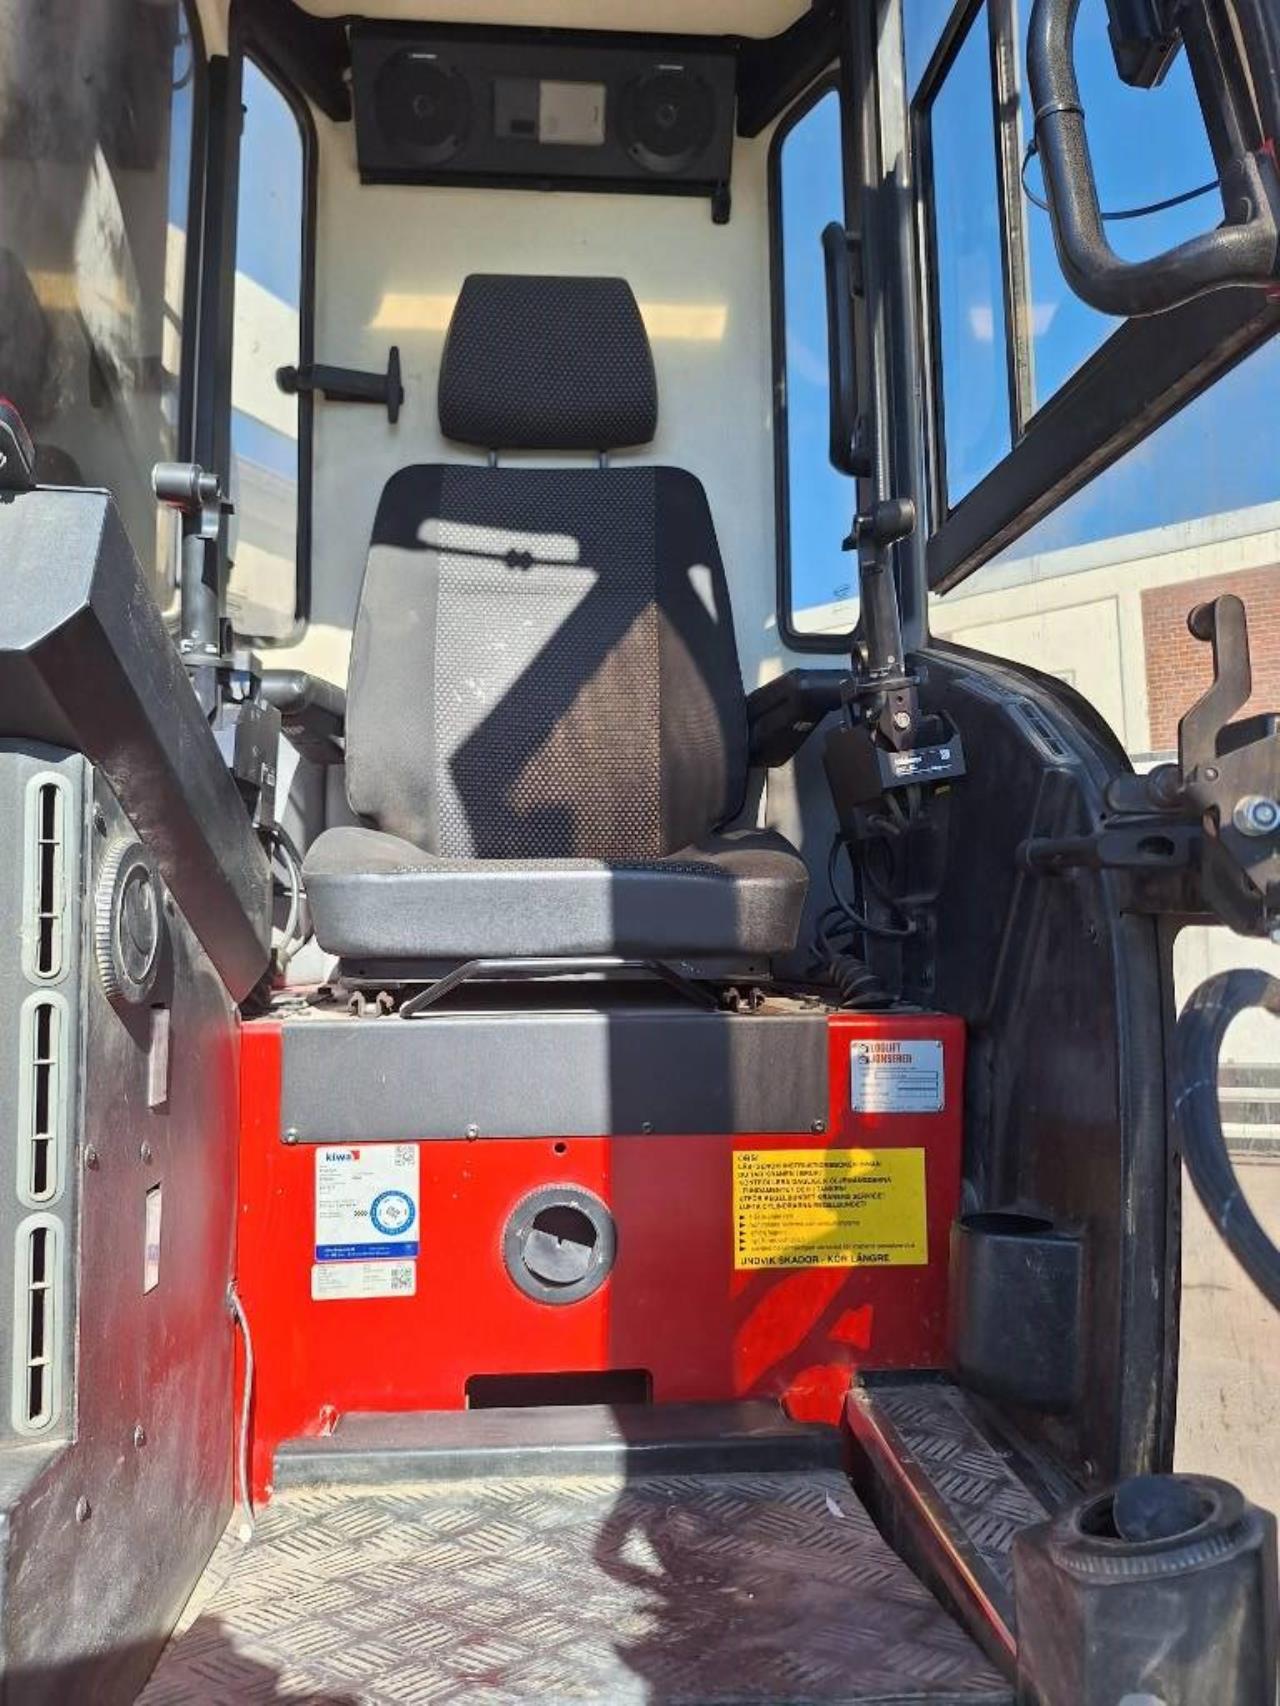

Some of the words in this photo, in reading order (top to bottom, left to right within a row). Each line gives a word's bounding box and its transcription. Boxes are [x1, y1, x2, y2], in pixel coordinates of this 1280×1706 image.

[326, 1151, 351, 1162] kiwa
[741, 1256, 776, 1265] UNDVIK
[779, 1255, 819, 1264] SKADOR
